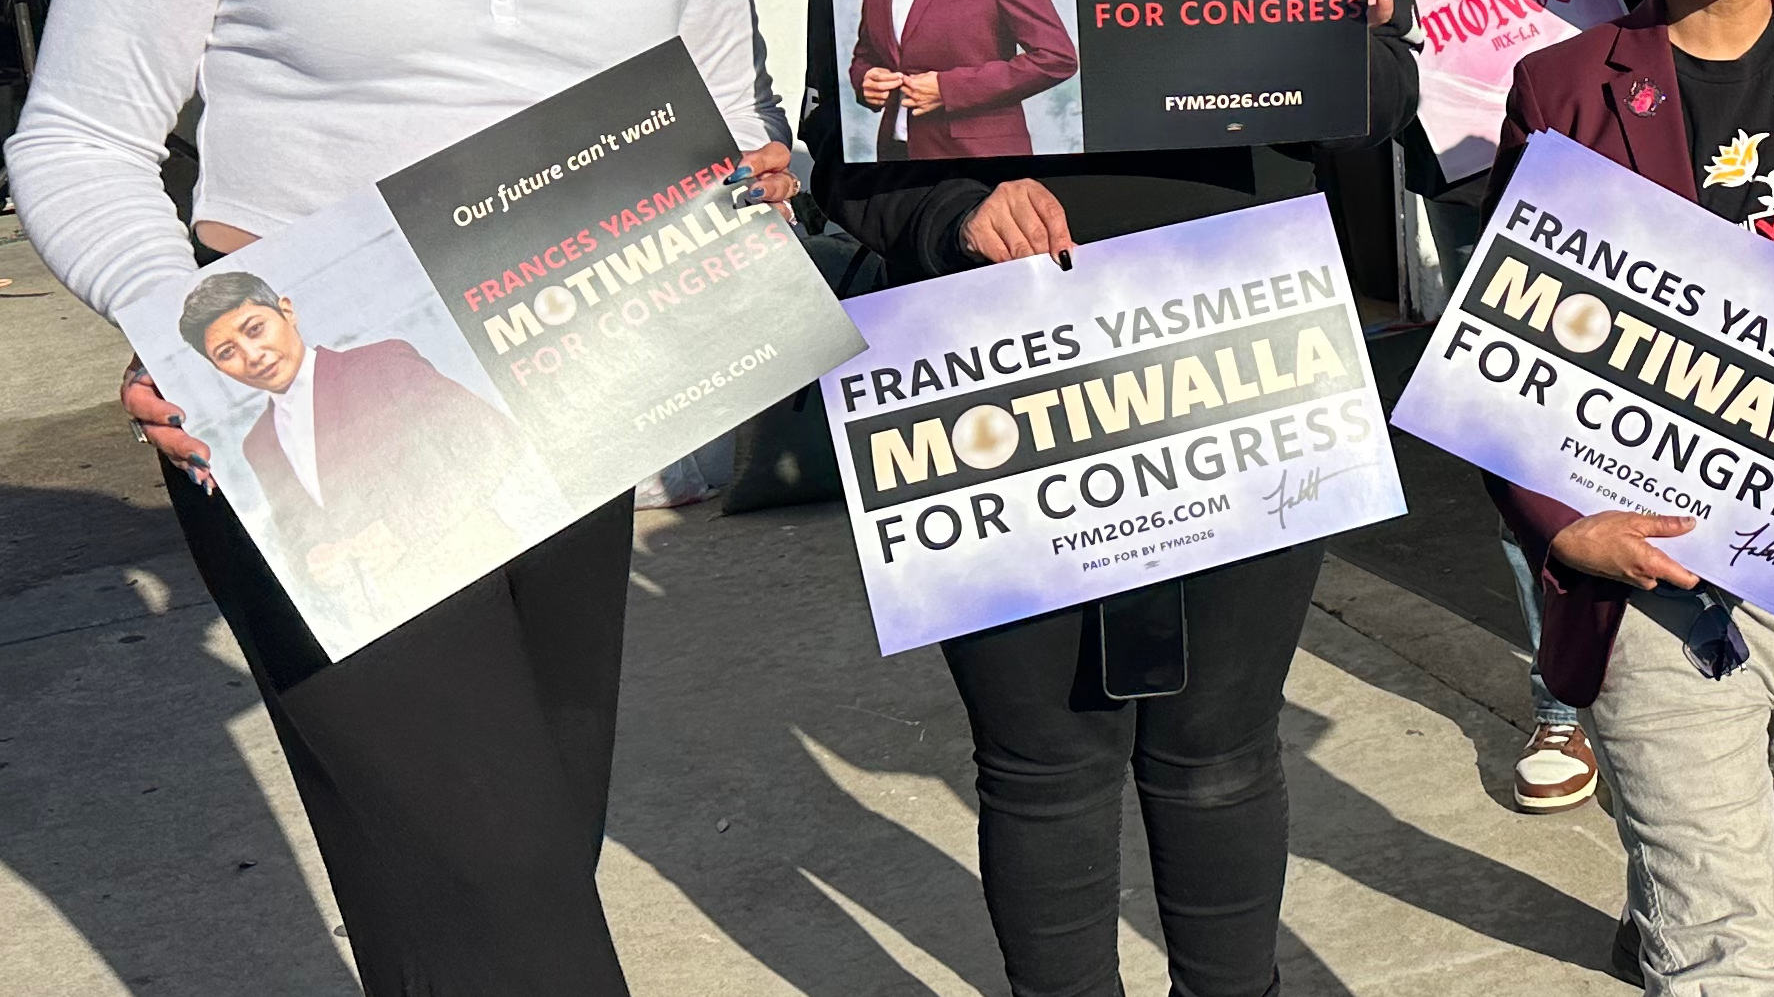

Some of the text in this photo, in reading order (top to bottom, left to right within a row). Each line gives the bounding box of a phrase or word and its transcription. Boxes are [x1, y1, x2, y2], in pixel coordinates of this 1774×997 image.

[1094, 2, 1164, 28] FOR
[1165, 90, 1303, 112] FYM2026.COM
[452, 102, 677, 228] Our future can't wait!
[462, 228, 598, 313] FRANCES
[1506, 199, 1706, 318] FRANCES
[509, 222, 790, 388] FOR CONGRESS
[840, 264, 1336, 412] FRANCES YASMEEN
[632, 342, 778, 433] FYM2026.COM
[1443, 321, 1559, 406] FOR
[869, 326, 1349, 493] MOTIWALLA
[876, 492, 1012, 564] FOR
[1036, 397, 1373, 520] CONGRESS
[1559, 436, 1712, 520] FYM2026.COM
[1569, 472, 1634, 508] PAID FOR BY
[1051, 493, 1231, 556] FYM2026.COM
[1082, 529, 1215, 572] PAID FOR BY FYM2026
